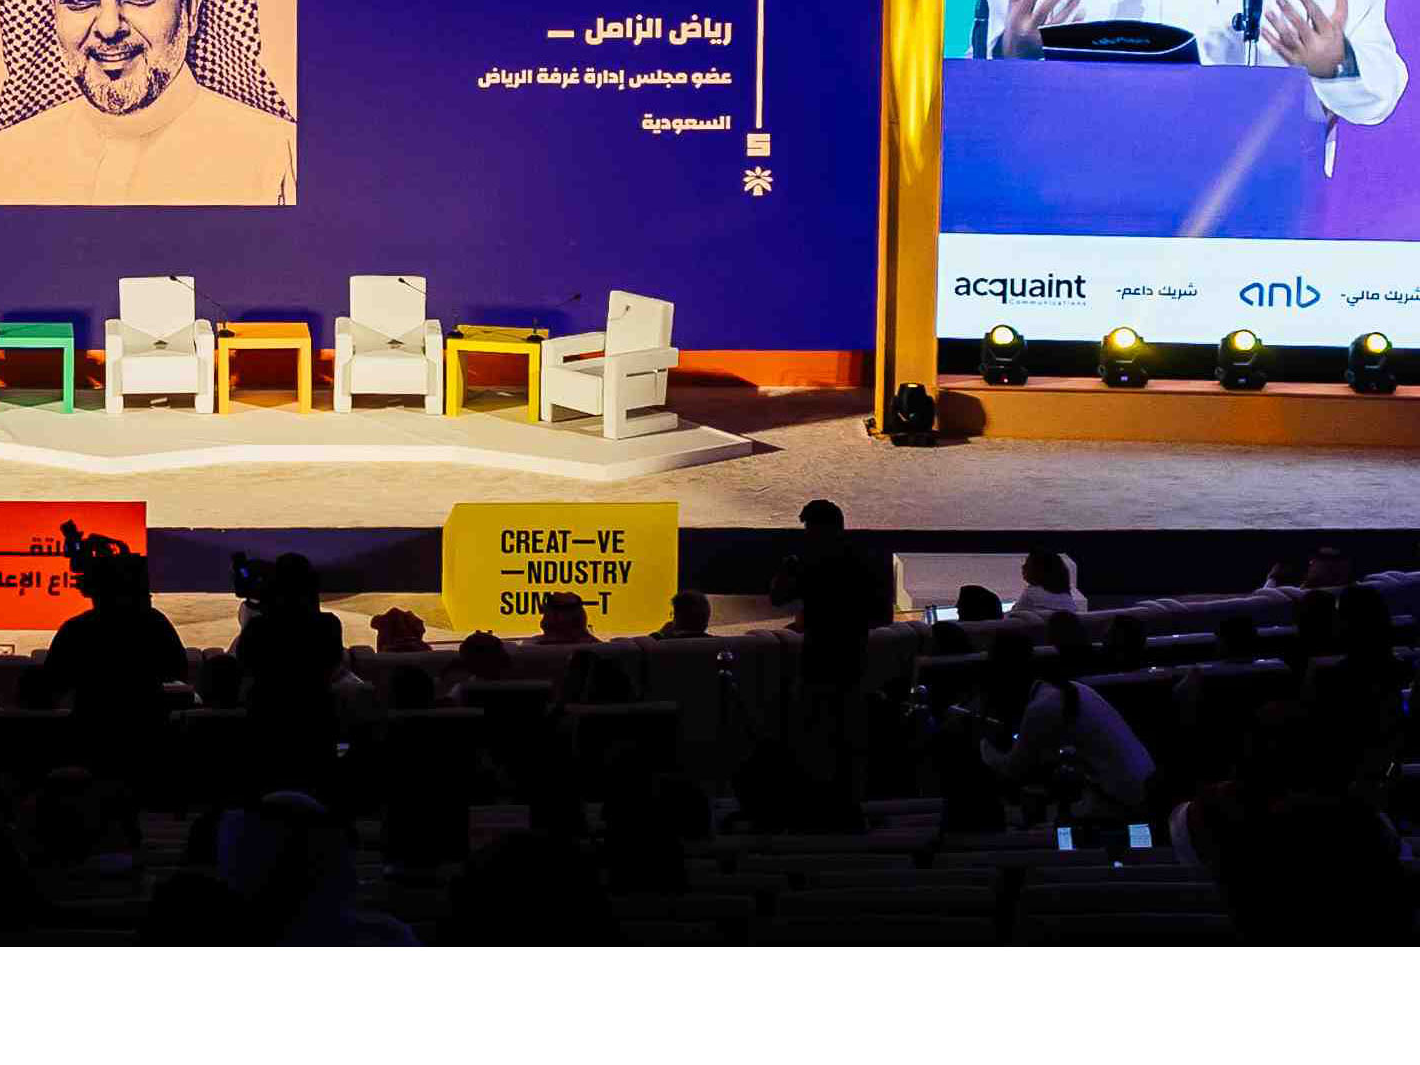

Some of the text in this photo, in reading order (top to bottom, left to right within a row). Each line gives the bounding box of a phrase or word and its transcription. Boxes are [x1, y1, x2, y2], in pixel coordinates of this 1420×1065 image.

[584, 14, 732, 46] رياض الزامل
[477, 67, 733, 91] عضو مجلس إدارة غرفة الرياض
[641, 113, 732, 135] السعودية
[954, 272, 1087, 306] acquaint
[1158, 283, 1199, 301] شريك
[1238, 275, 1322, 309] anb
